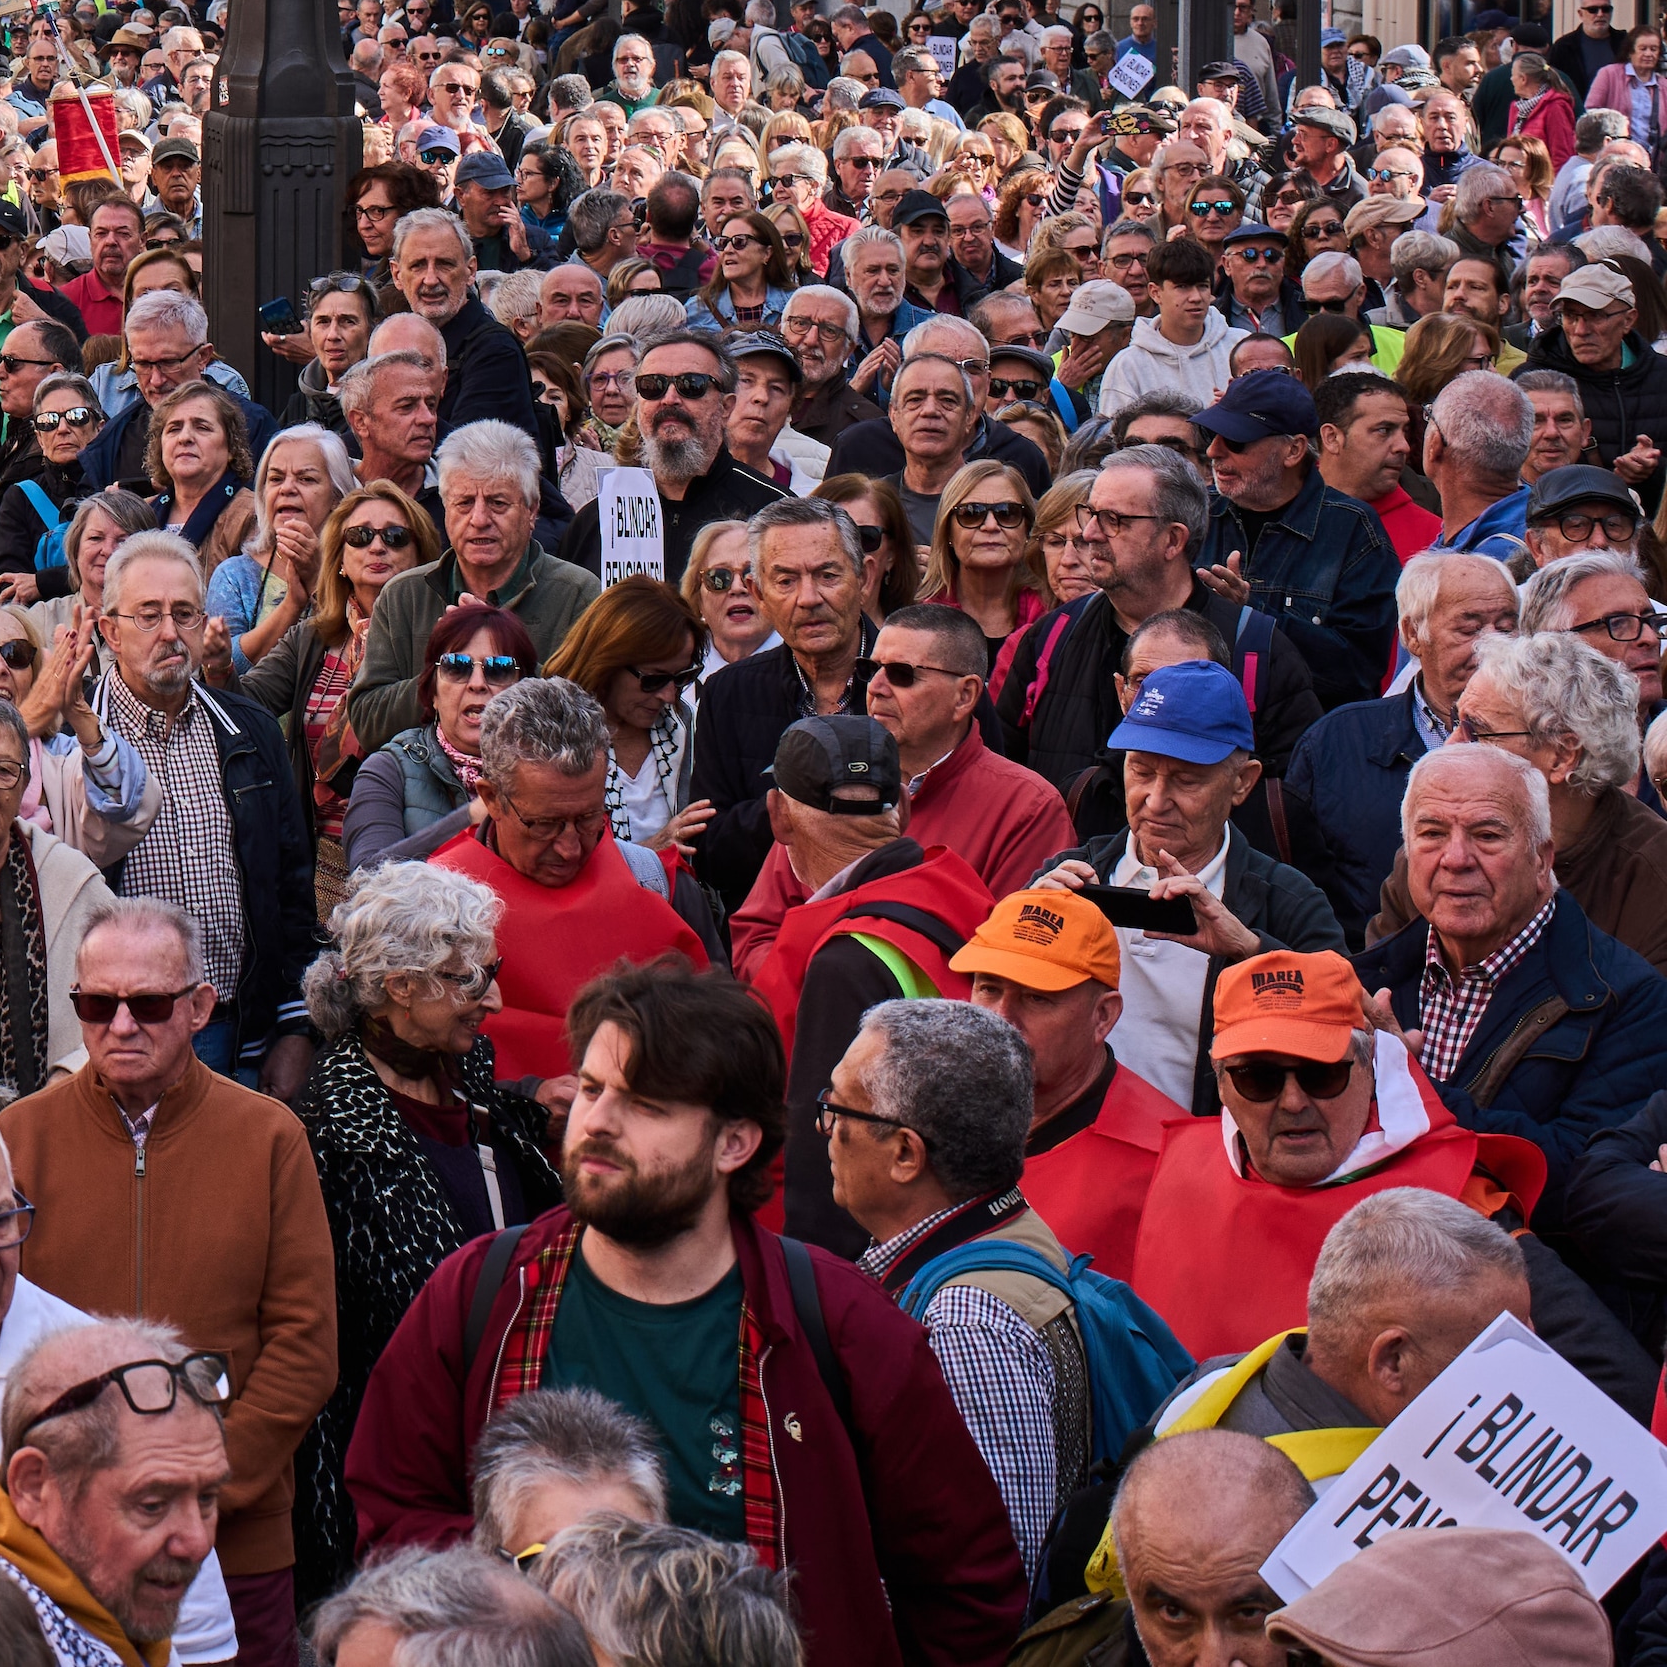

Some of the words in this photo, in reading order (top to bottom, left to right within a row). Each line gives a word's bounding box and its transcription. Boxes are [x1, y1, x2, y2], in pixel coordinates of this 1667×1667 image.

[932, 43, 953, 56] BLINDAR
[616, 495, 658, 538] BLINDAR
[1020, 905, 1064, 930] MAREA
[1251, 970, 1304, 990] MAREA
[1453, 1392, 1639, 1567] BLINDAR
